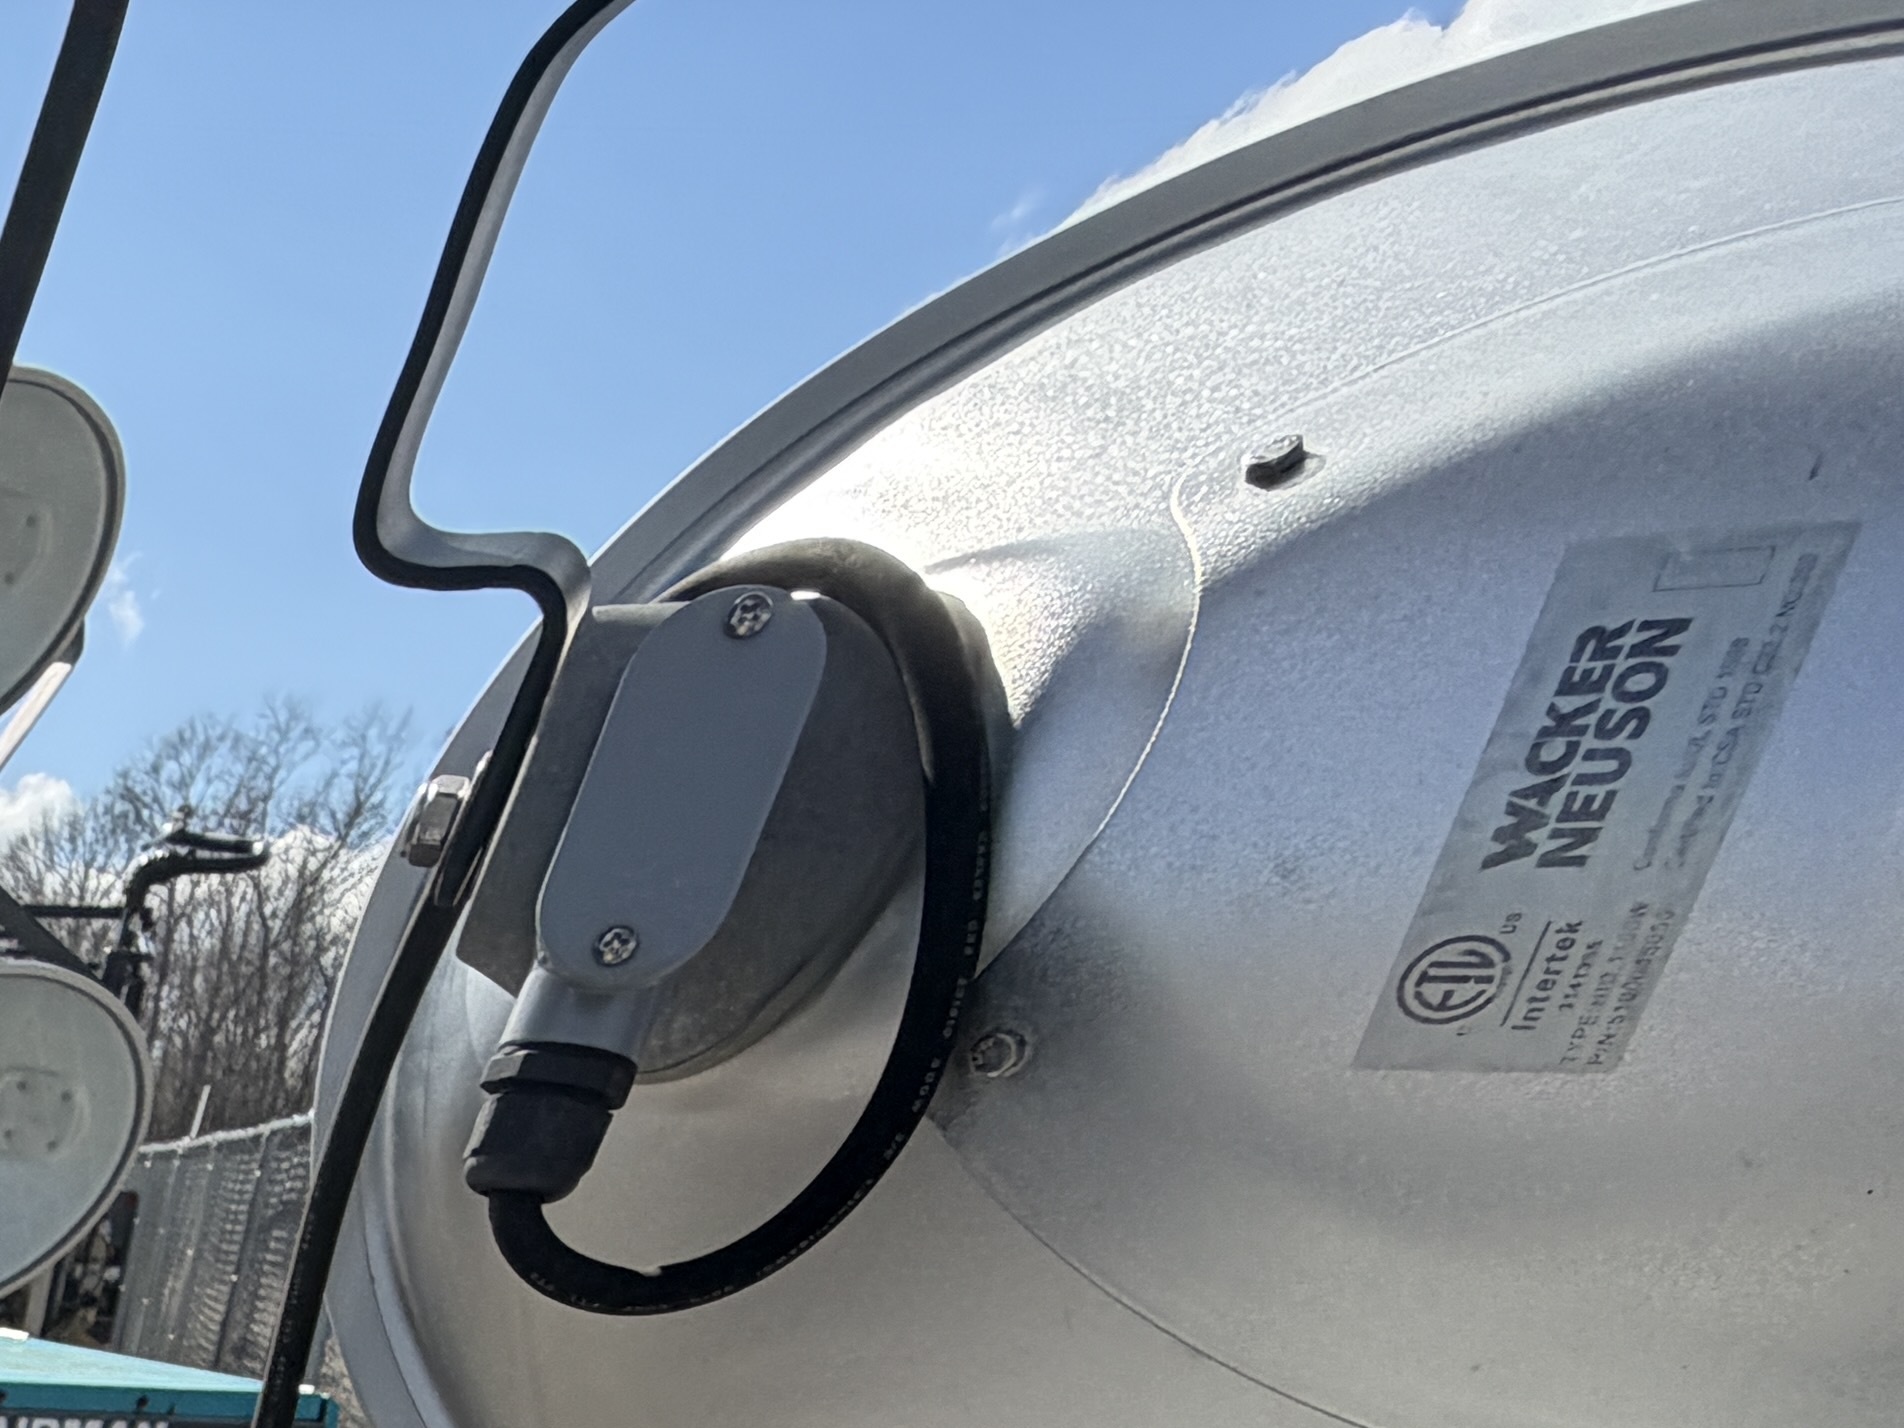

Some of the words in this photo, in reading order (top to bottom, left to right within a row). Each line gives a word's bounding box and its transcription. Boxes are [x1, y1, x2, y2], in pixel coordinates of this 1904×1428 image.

[1482, 623, 1631, 868] WACKER
[1539, 619, 1689, 868] NEUSON
[1511, 921, 1583, 1031] Intertek
